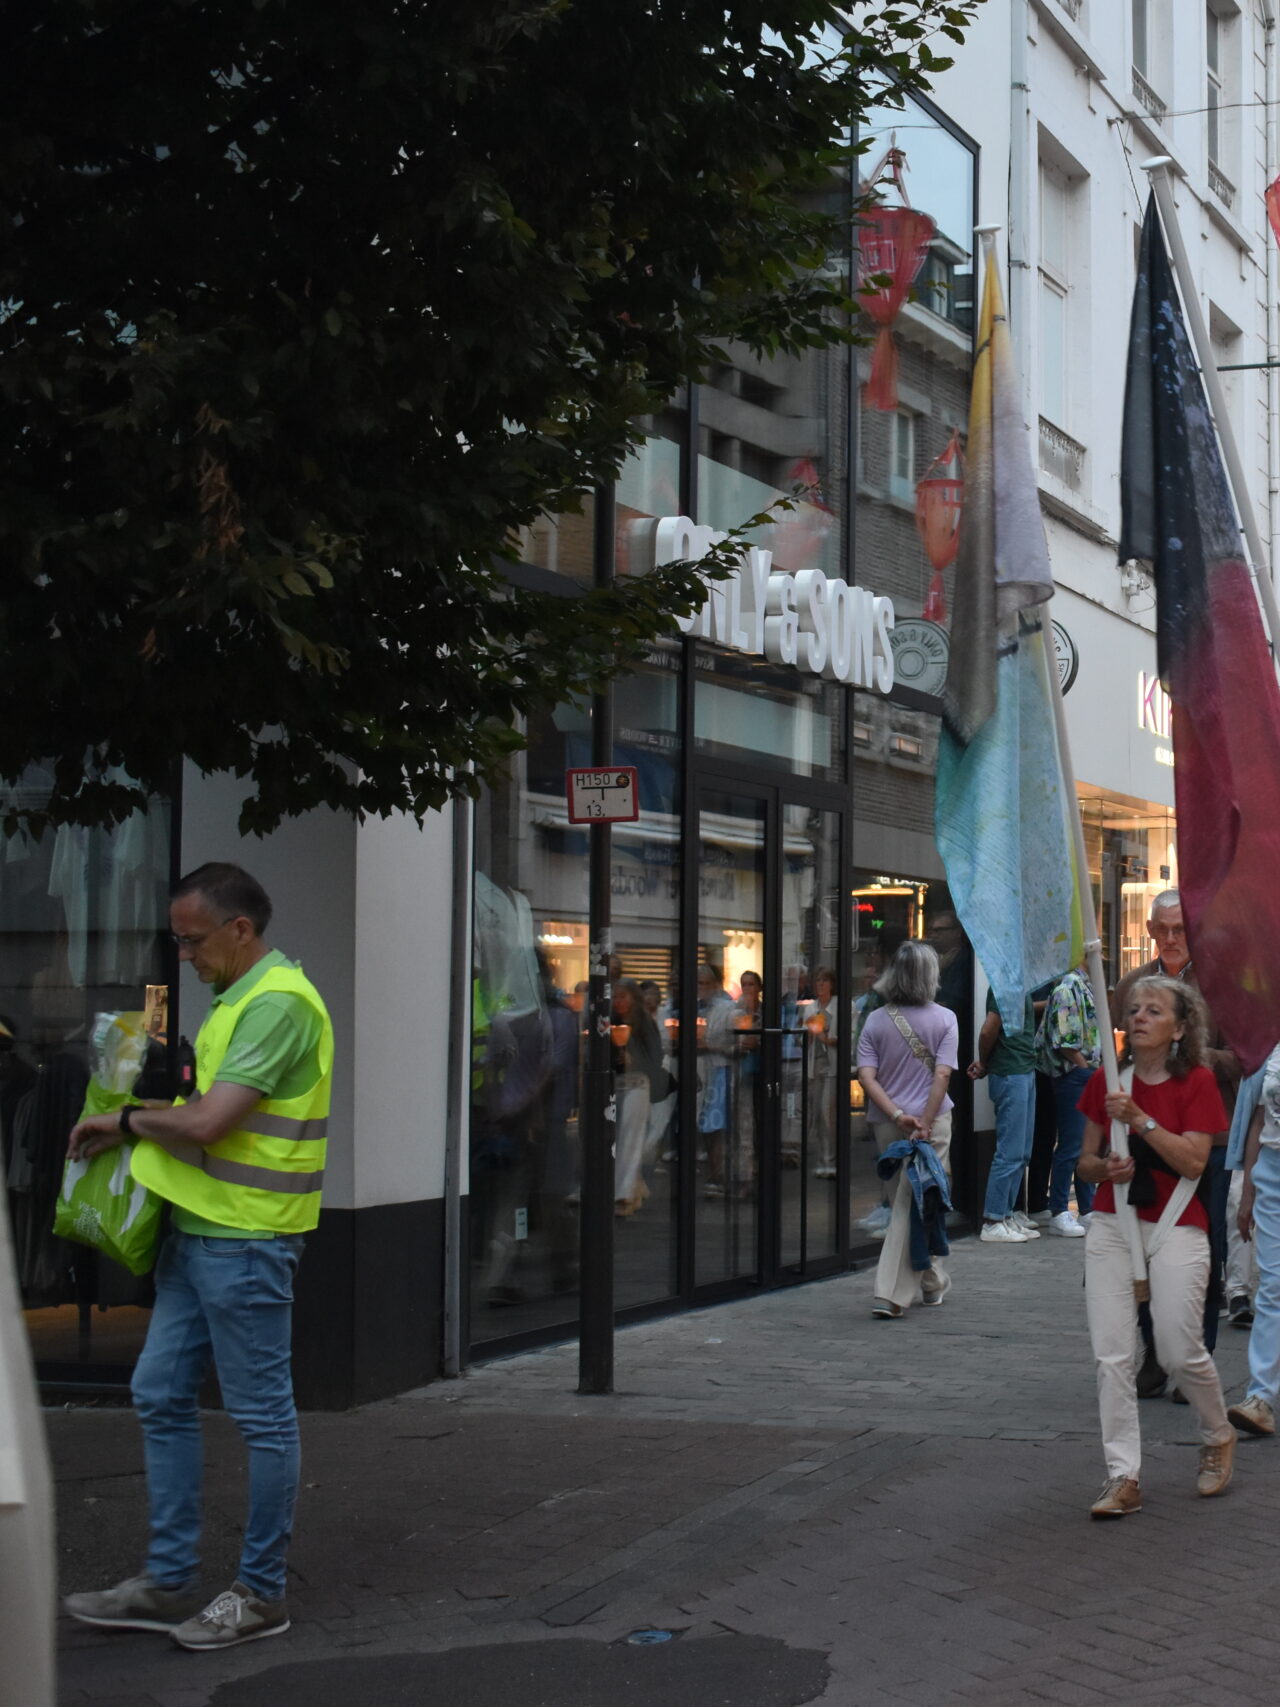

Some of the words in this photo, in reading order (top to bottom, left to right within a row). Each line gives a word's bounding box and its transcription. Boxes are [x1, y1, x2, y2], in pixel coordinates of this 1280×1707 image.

[765, 574, 798, 665] &
[795, 569, 895, 694] SONS
[576, 774, 611, 787] H150
